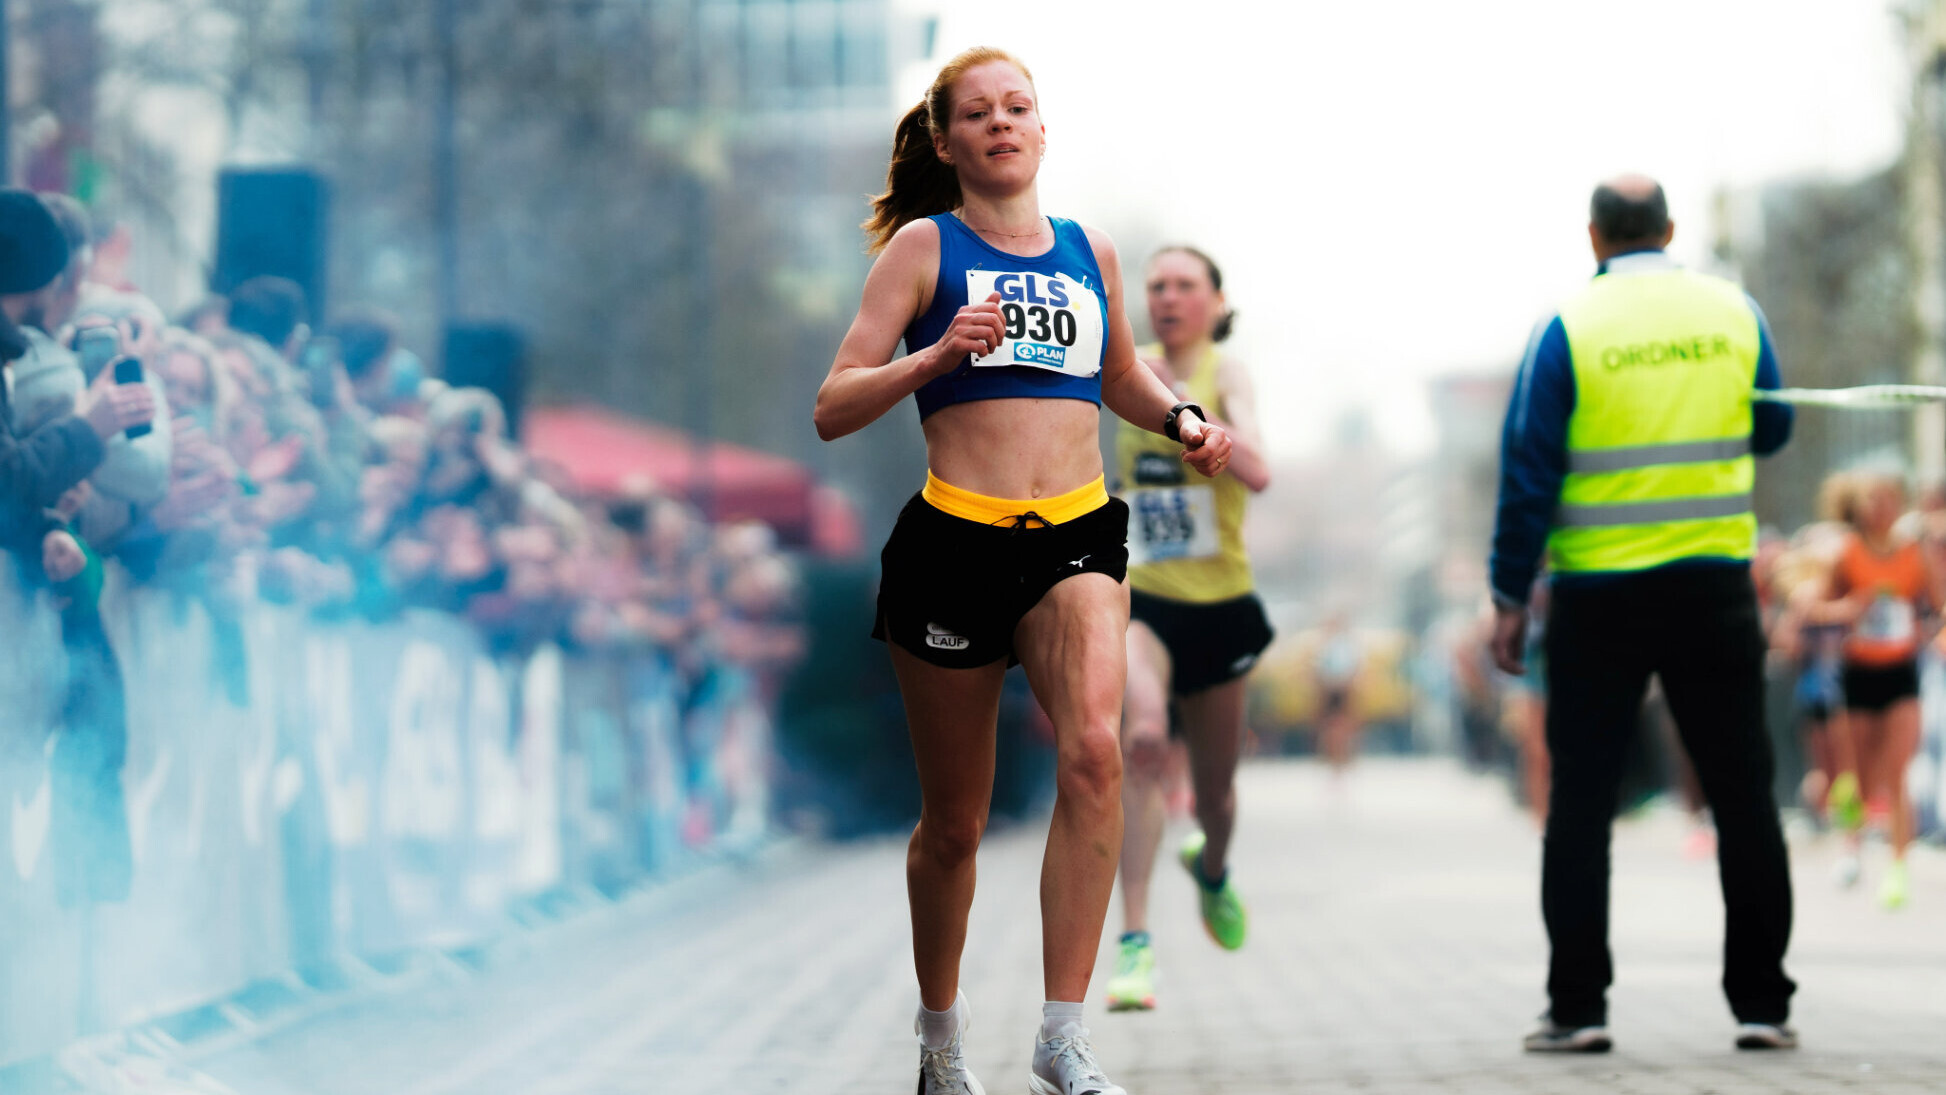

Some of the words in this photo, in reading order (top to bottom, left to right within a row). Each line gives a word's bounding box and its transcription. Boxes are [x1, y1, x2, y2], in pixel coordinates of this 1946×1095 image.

[994, 273, 1069, 307] GLS
[1001, 303, 1077, 347] 930
[1036, 346, 1064, 361] PLAN
[1602, 335, 1730, 371] ORDNER
[932, 635, 964, 647] LAUF
